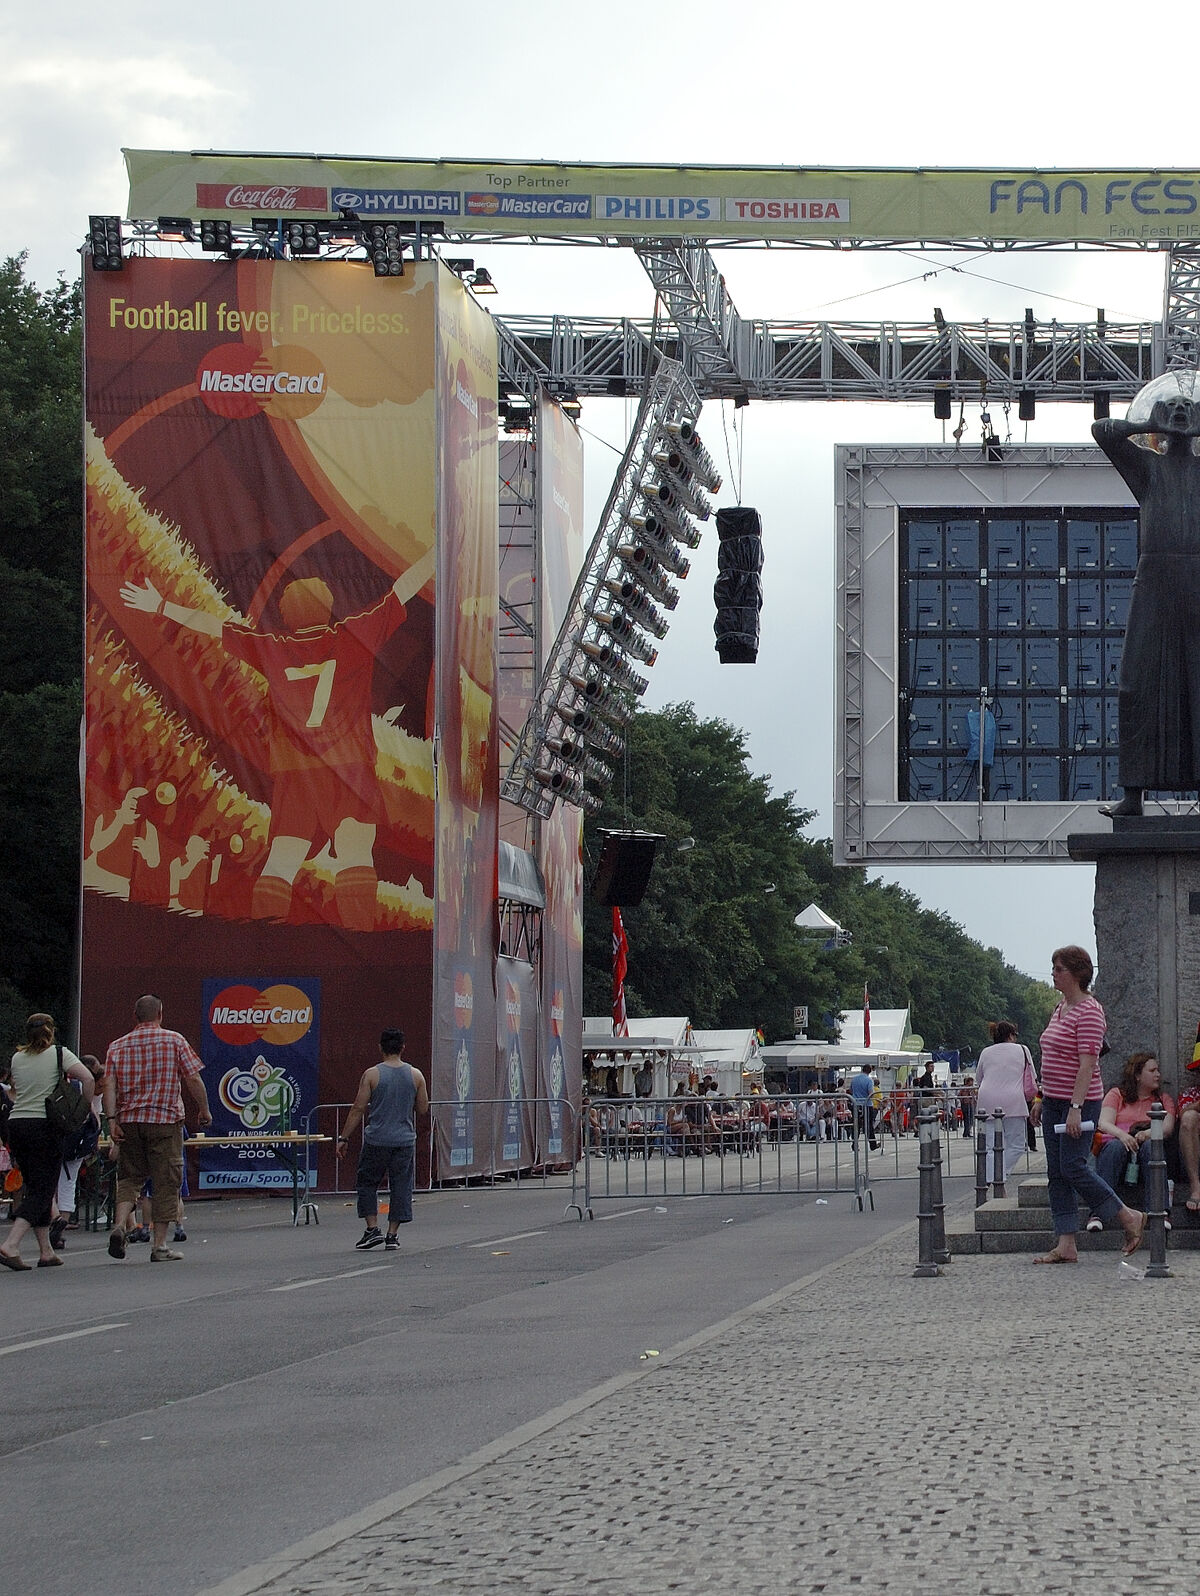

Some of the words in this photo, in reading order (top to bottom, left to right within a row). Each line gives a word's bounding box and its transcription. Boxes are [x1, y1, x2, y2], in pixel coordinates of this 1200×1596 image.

[486, 173, 512, 189] Top
[517, 175, 571, 189] Partner
[225, 185, 299, 209] Coca-Cola
[364, 193, 459, 211] HYUNDAI
[501, 197, 589, 215] MasterCard
[989, 180, 1089, 215] FAN
[604, 196, 711, 220] PHILIPS
[734, 200, 841, 220] TOSHIBA
[1109, 224, 1137, 237] Fan
[1141, 224, 1172, 237] Fest
[109, 298, 208, 332] Football
[216, 303, 285, 333] fever.
[292, 304, 410, 335] Priceless.
[200, 370, 326, 393] MasterCard
[211, 1006, 312, 1025] MasterCard
[238, 1150, 276, 1159] 2006
[206, 1173, 253, 1185] Official
